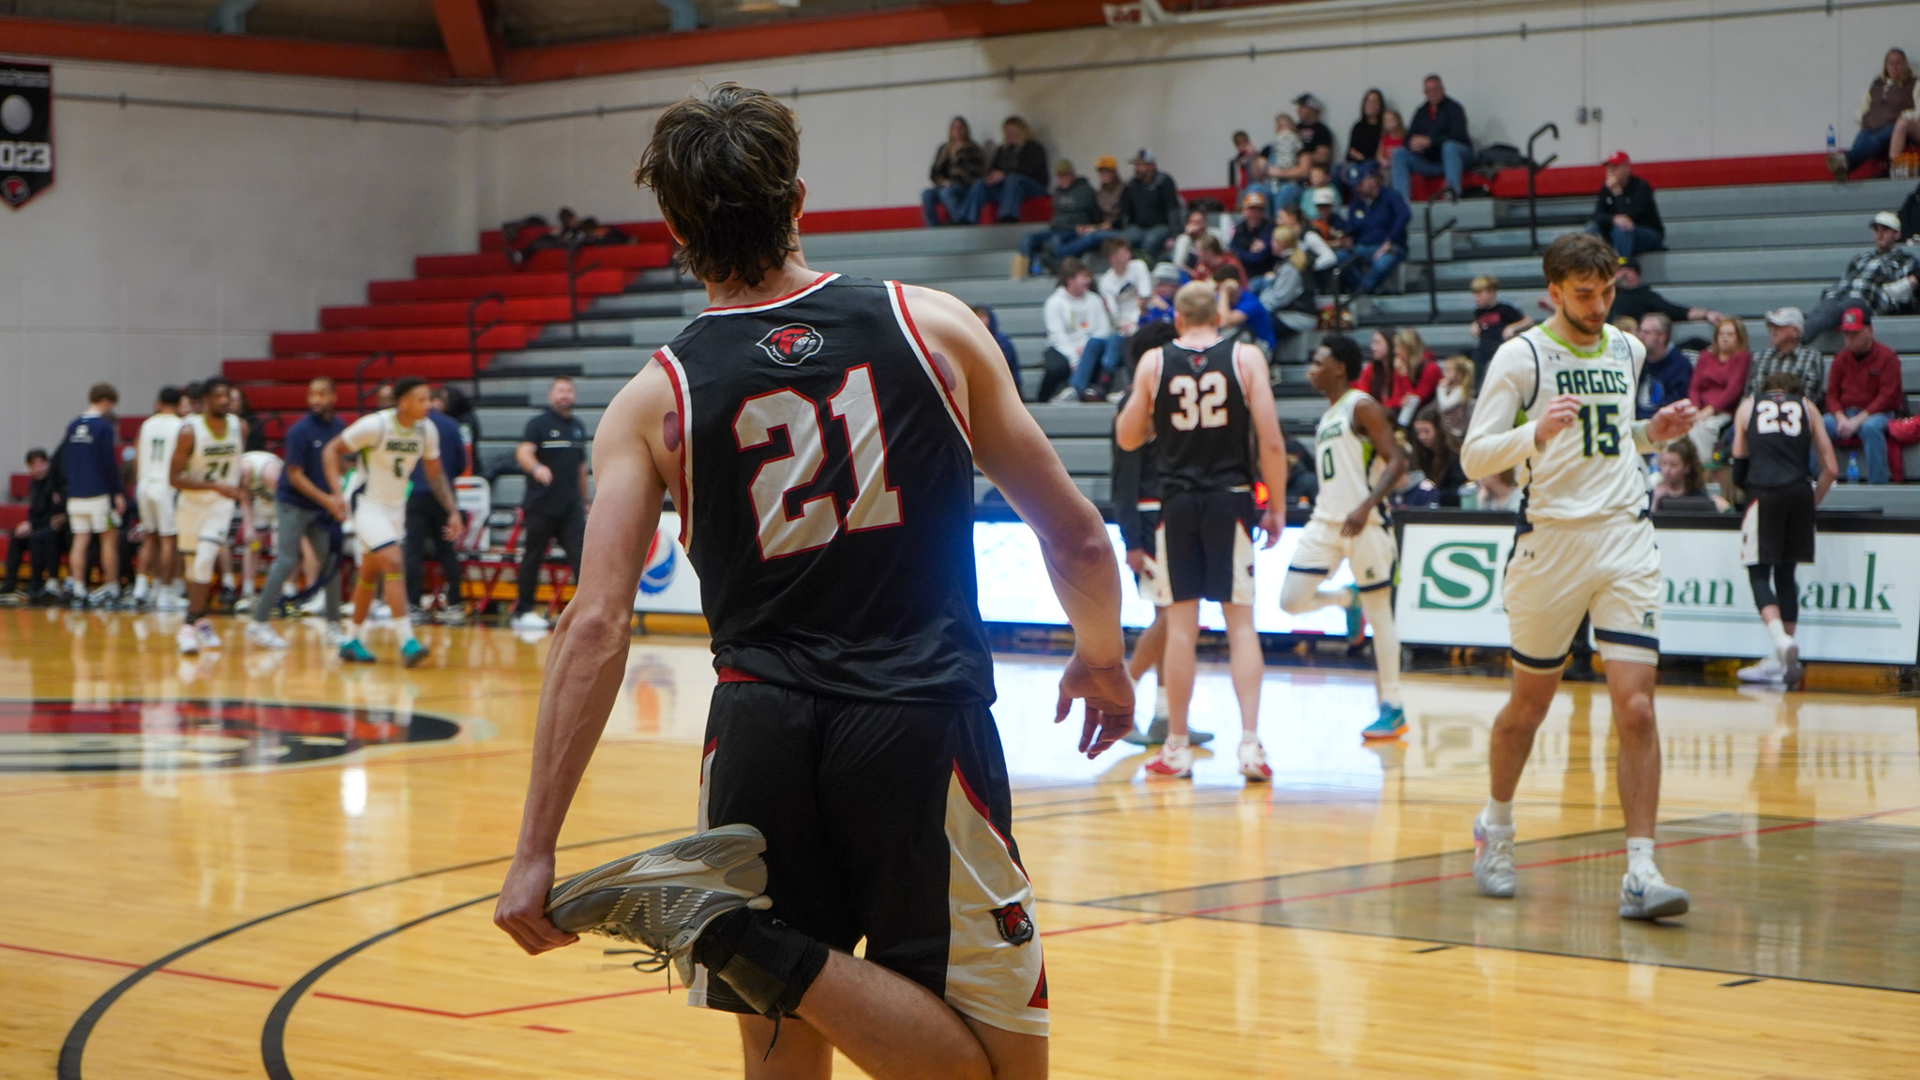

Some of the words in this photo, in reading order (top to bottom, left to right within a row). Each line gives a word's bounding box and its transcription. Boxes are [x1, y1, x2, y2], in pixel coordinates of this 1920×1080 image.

[0, 141, 51, 172] 023
[1168, 370, 1229, 431] 32
[1556, 368, 1628, 395] ARGOS
[1577, 403, 1621, 458] 15
[1756, 399, 1803, 437] 23
[731, 362, 904, 562] 21
[1322, 447, 1335, 481] 0
[1795, 551, 1897, 611] ank
